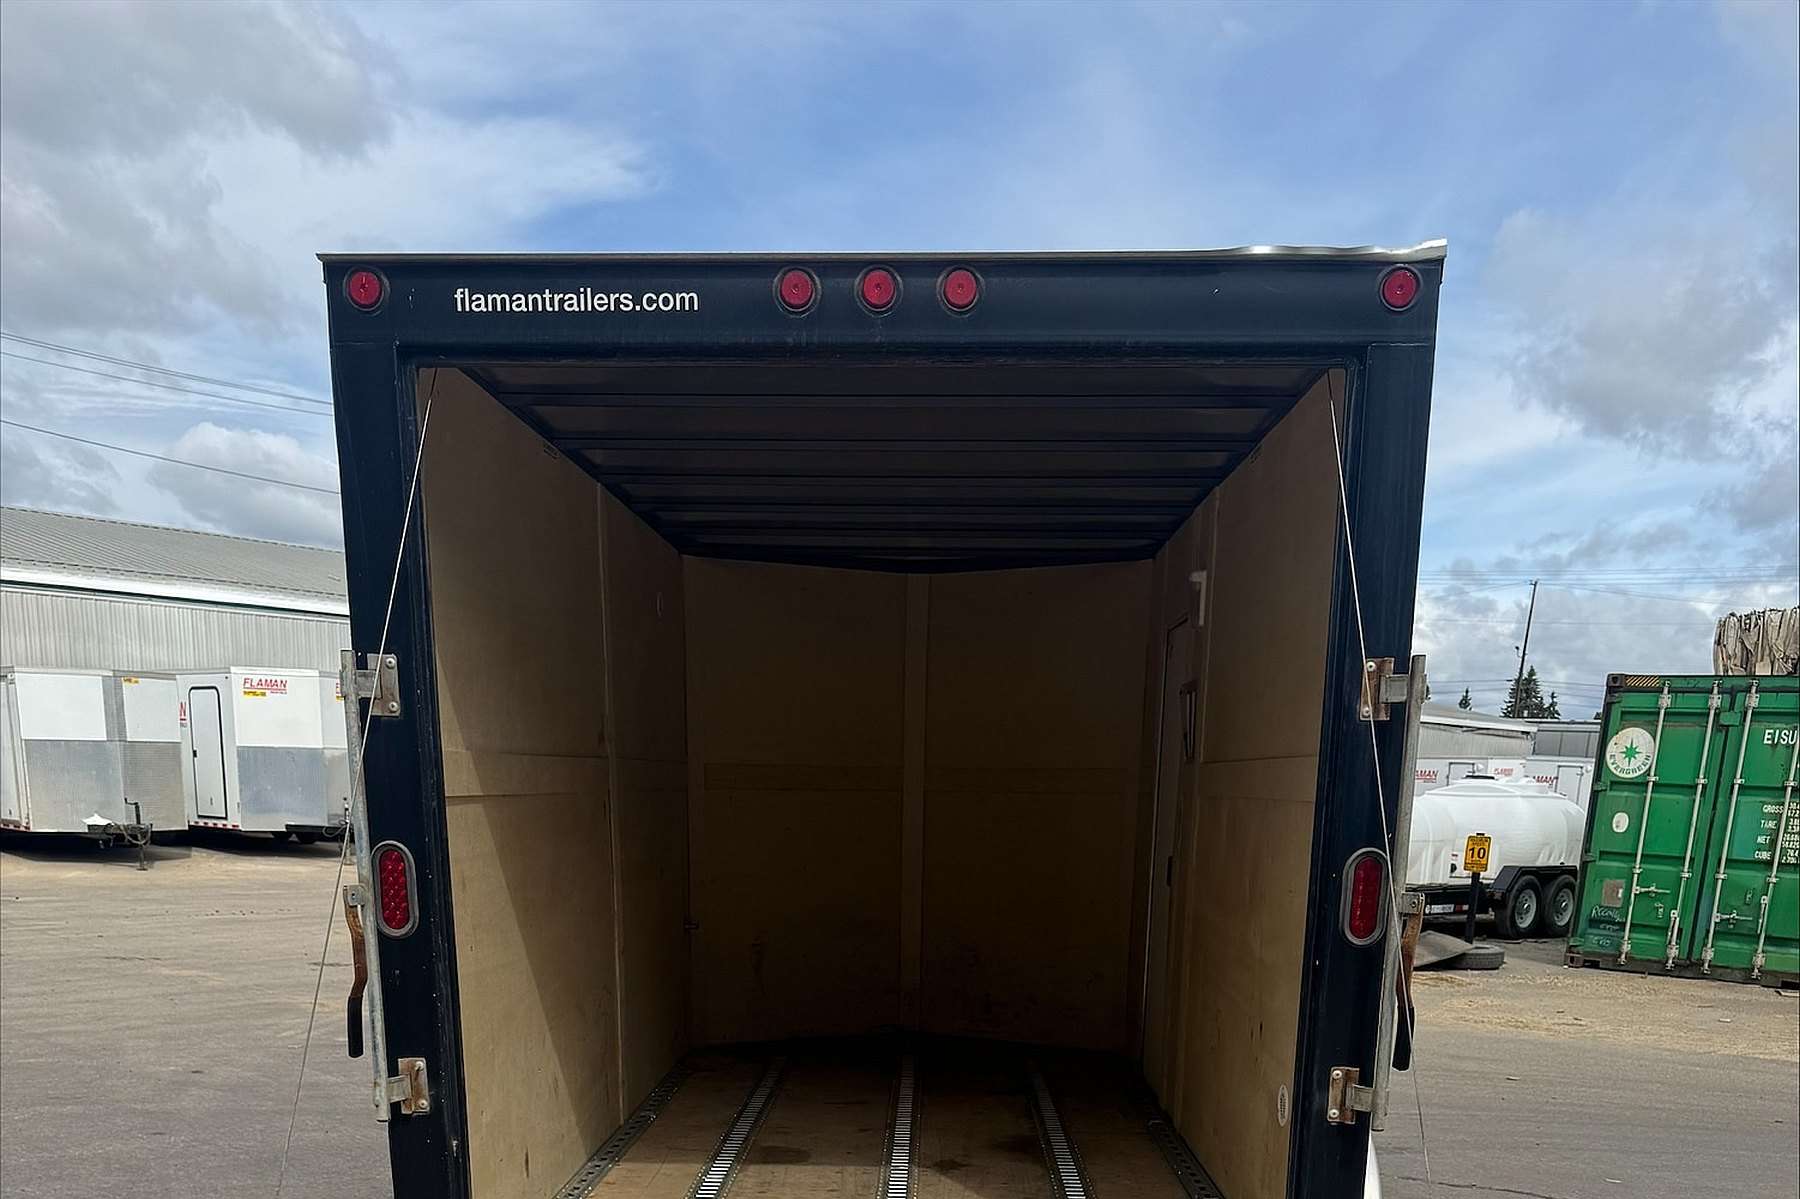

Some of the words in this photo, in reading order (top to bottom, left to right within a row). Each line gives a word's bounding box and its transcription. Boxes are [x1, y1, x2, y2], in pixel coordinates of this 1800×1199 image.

[454, 288, 699, 312] flamantrailers.com
[243, 678, 288, 688] FLAMAN
[1763, 729, 1797, 744] EISU
[1609, 753, 1651, 774] EVERGREEN
[1469, 847, 1486, 859] 10
